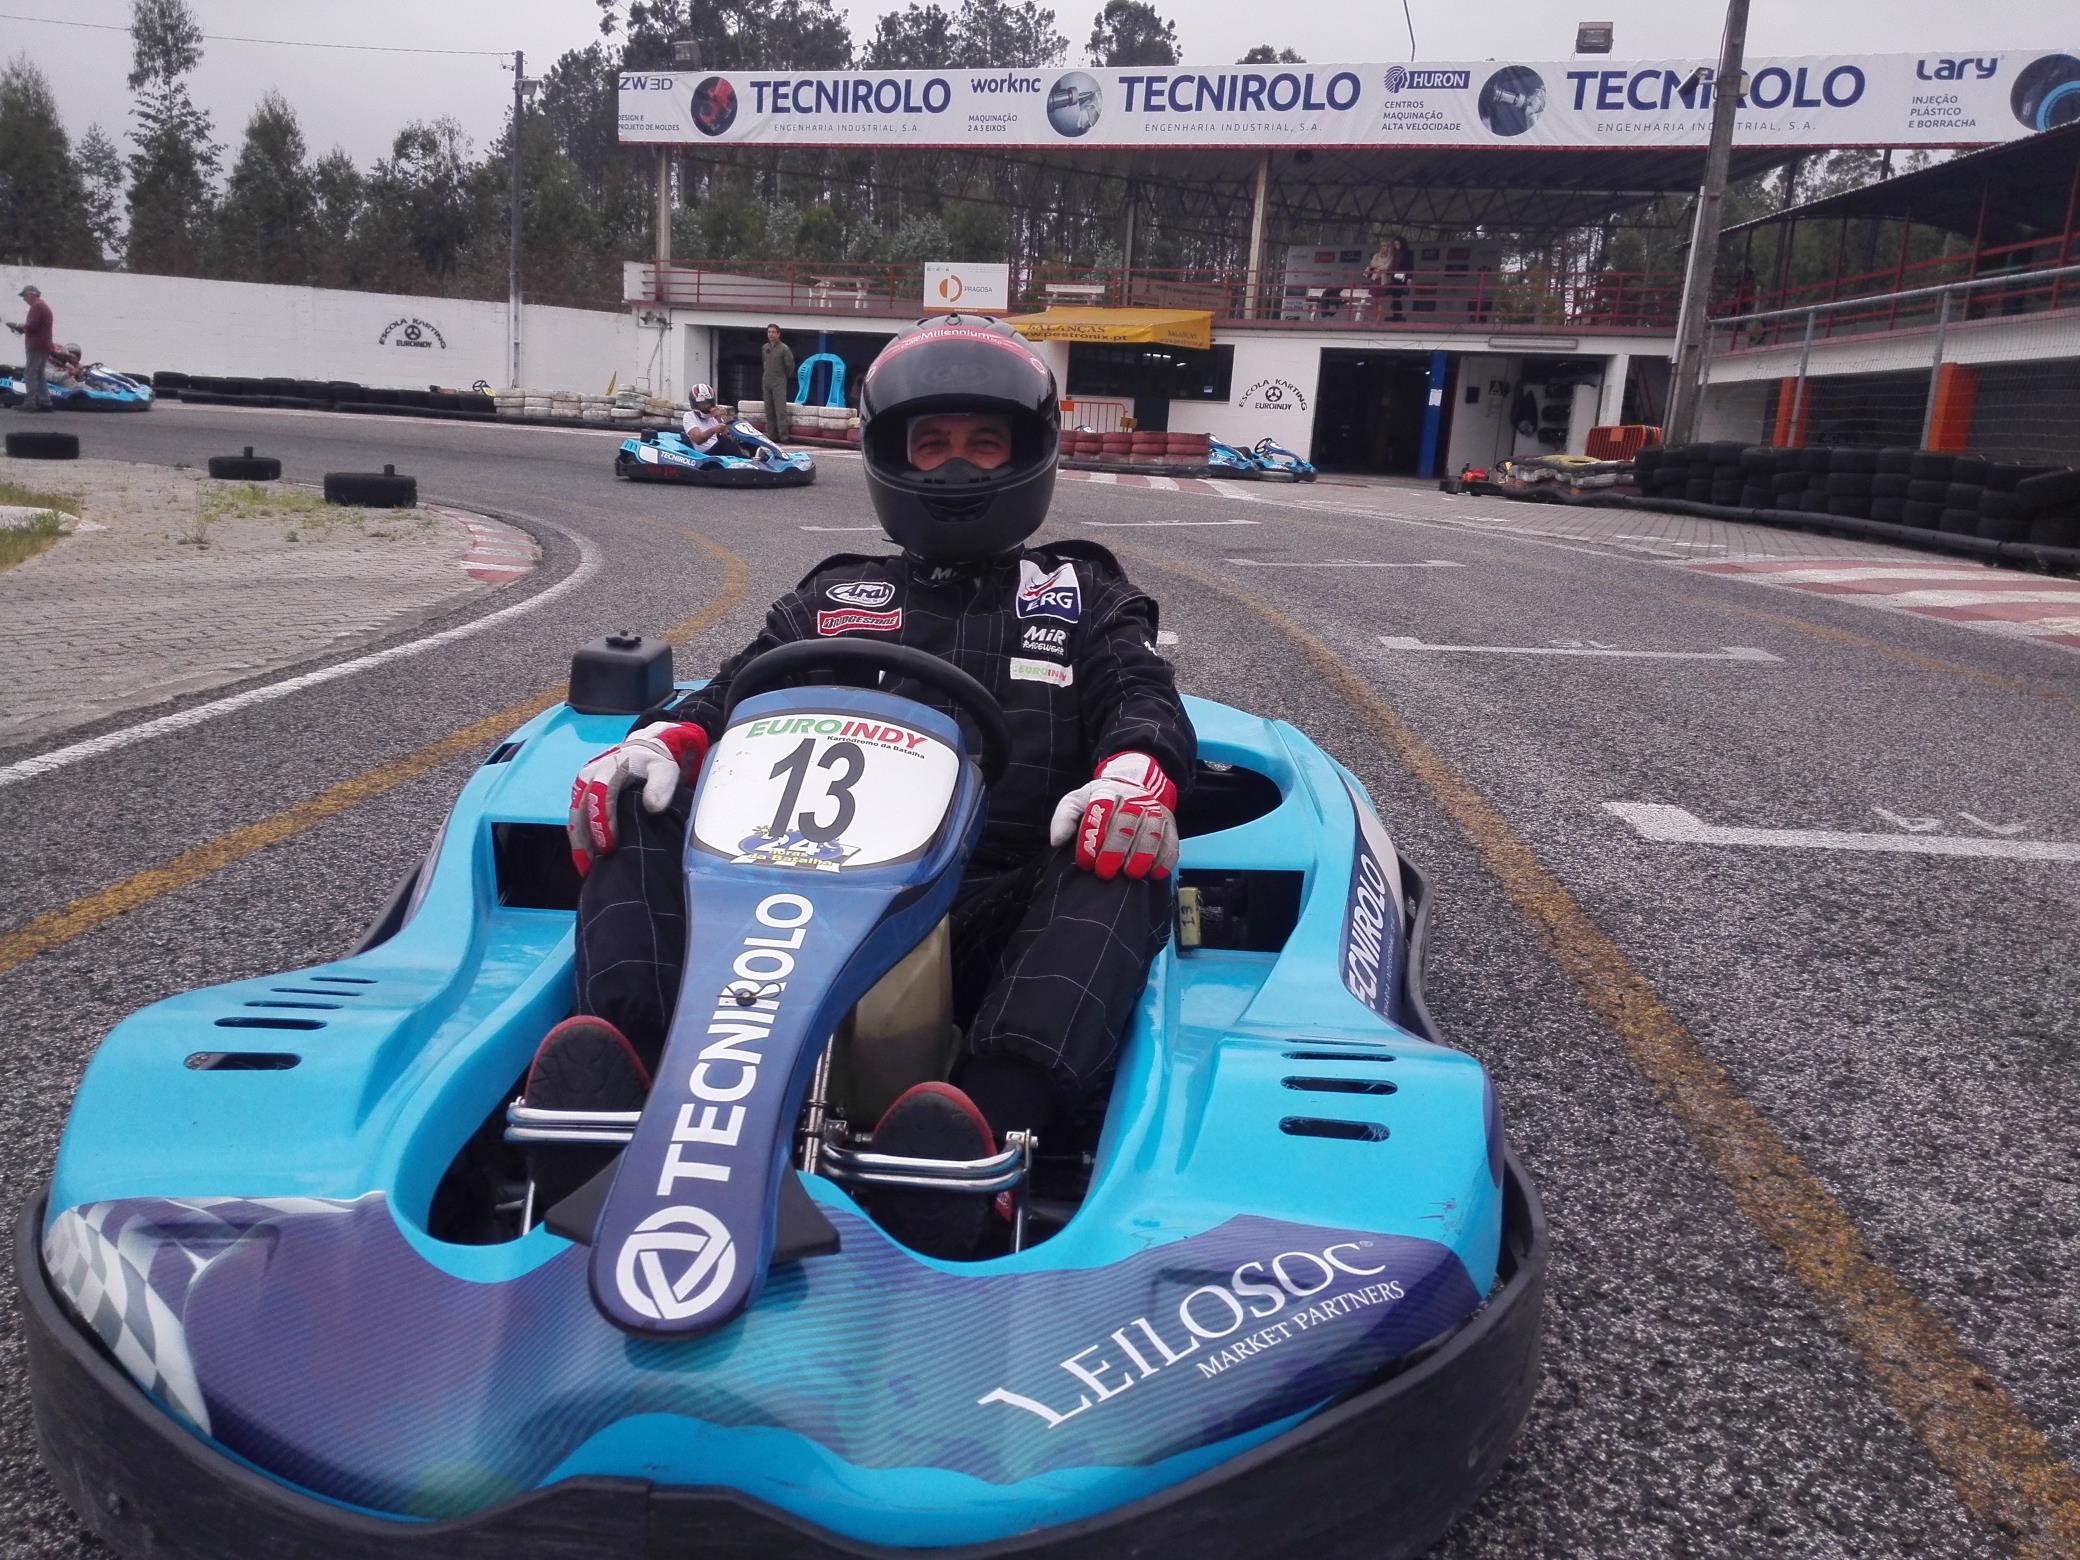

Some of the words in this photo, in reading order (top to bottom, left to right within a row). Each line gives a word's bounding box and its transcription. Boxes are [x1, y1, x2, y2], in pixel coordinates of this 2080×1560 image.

[970, 72, 1041, 95] worknc
[1413, 73, 1465, 87] HURON
[1119, 72, 1361, 112] TECNIROLO
[1566, 65, 1866, 110] TECNIOLO
[750, 78, 951, 114] TECNIROLO
[1912, 94, 1958, 105] INJEÇÃO
[1384, 101, 1424, 109] CENTROS
[1910, 106, 1962, 116] PLÁSTICO
[968, 113, 1017, 123] MAQUINAÇÃO
[1383, 110, 1443, 121] MAQUINAÇÃO
[774, 124, 834, 132] ENGENHARIA
[1145, 123, 1216, 132] ENGENHARIA
[1381, 123, 1404, 131] ALTA
[1406, 123, 1461, 131] VELOCIDADE
[1597, 122, 1685, 132] ENGENHARIA
[1908, 120, 1915, 128] E
[1917, 120, 1976, 128] BORRACHA
[921, 329, 991, 341] Millennium
[1239, 379, 1270, 408] ESCOLA
[1275, 378, 1308, 412] KARTING
[1255, 402, 1292, 410] EUROINDY
[660, 450, 696, 467] TECNIROLO
[1026, 592, 1073, 611] ERG
[745, 718, 928, 750] EUROINDY
[893, 745, 925, 759] Batalha
[769, 738, 865, 843] 13
[771, 854, 833, 866] Batalha
[1349, 854, 1385, 1009] ECNIROLO
[656, 893, 814, 1196] TECNIROLO
[1197, 1321, 1294, 1379] MARKET
[1290, 1280, 1405, 1331] PARTNERS
